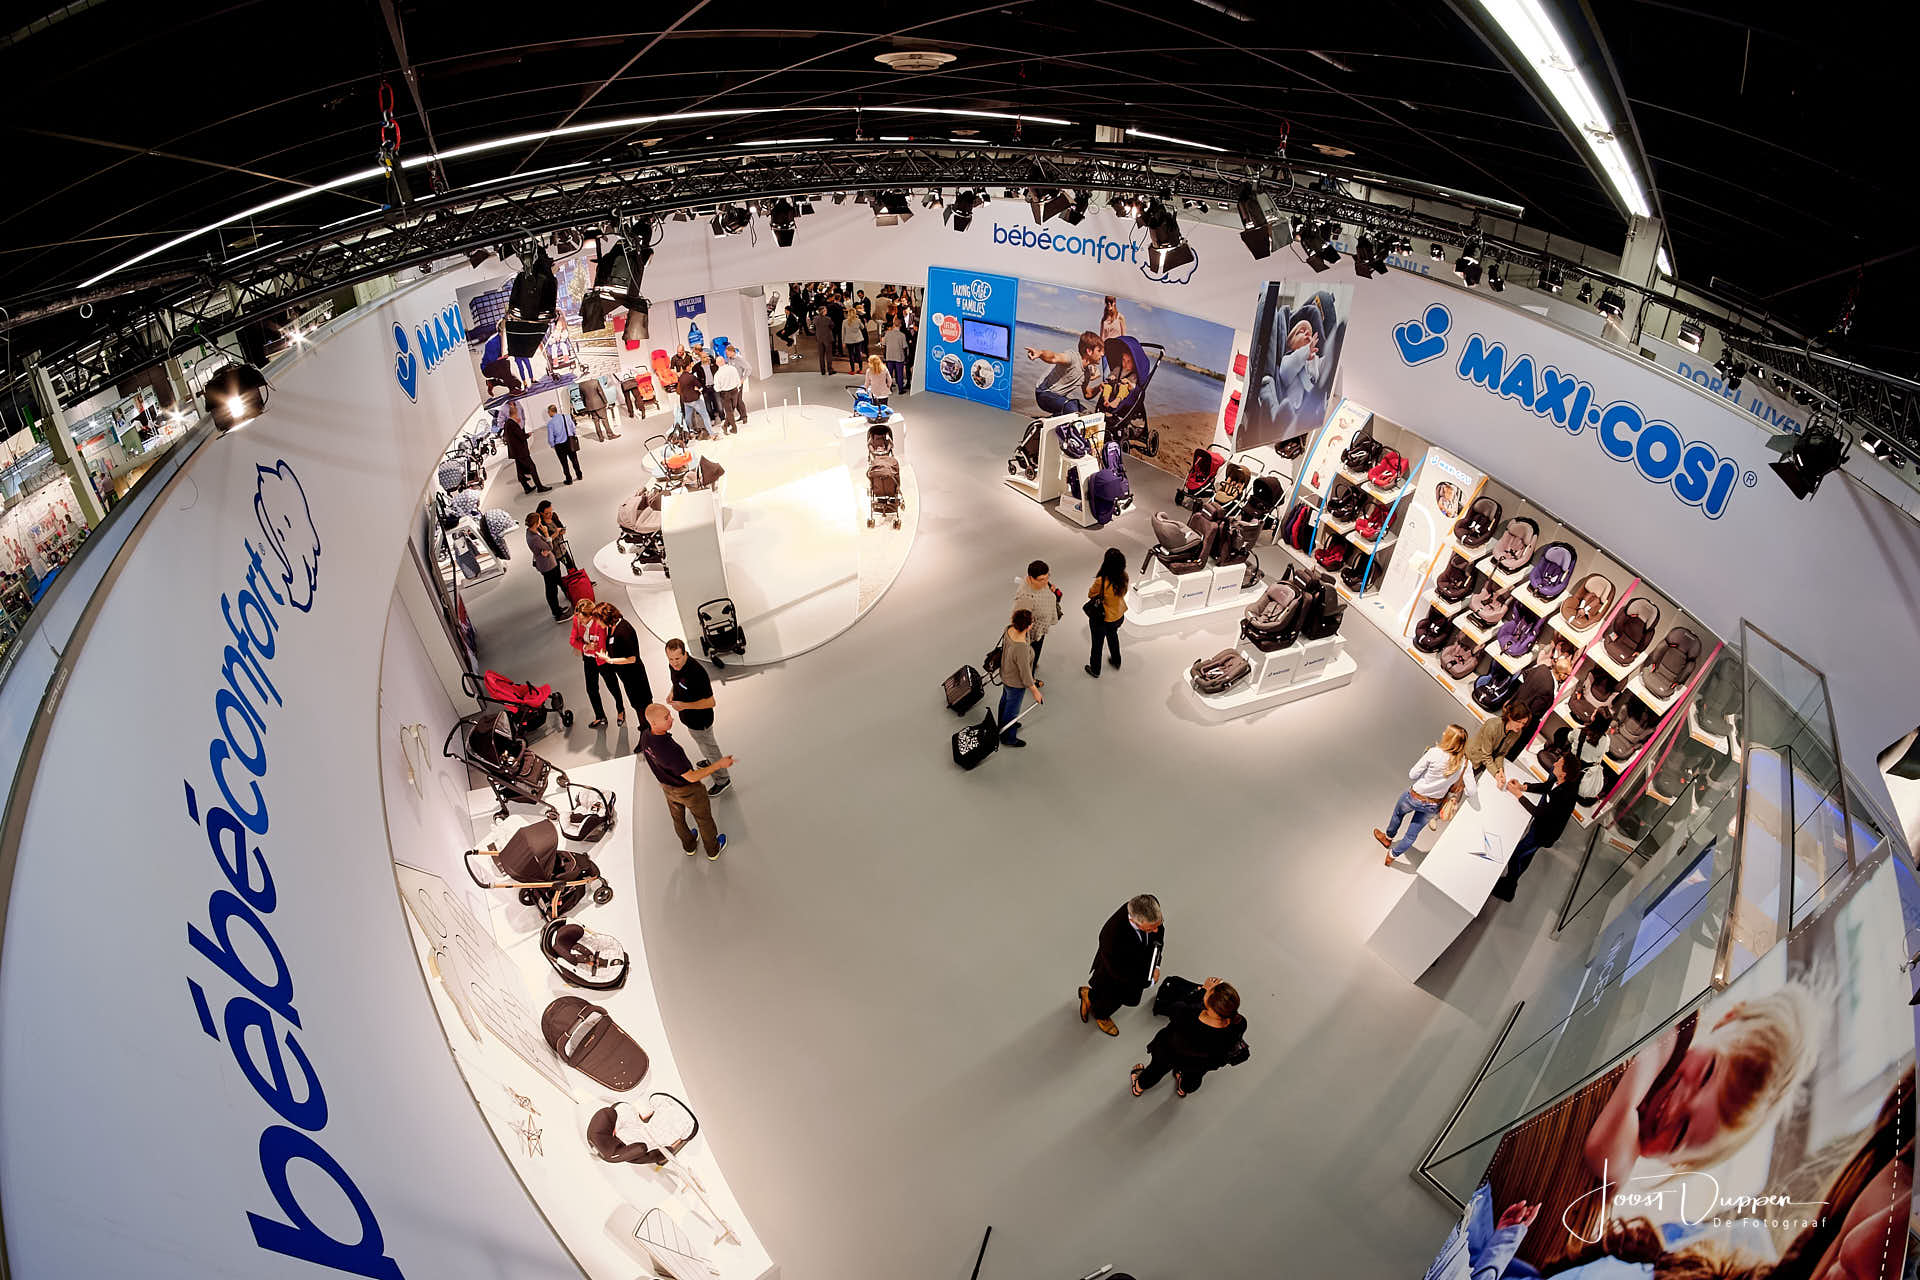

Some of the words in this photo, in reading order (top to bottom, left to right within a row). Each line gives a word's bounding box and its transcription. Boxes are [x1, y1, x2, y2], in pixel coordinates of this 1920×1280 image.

[993, 223, 1138, 264] bébéconfort
[416, 303, 466, 371] MAXI
[184, 536, 407, 1280] bébéconfort
